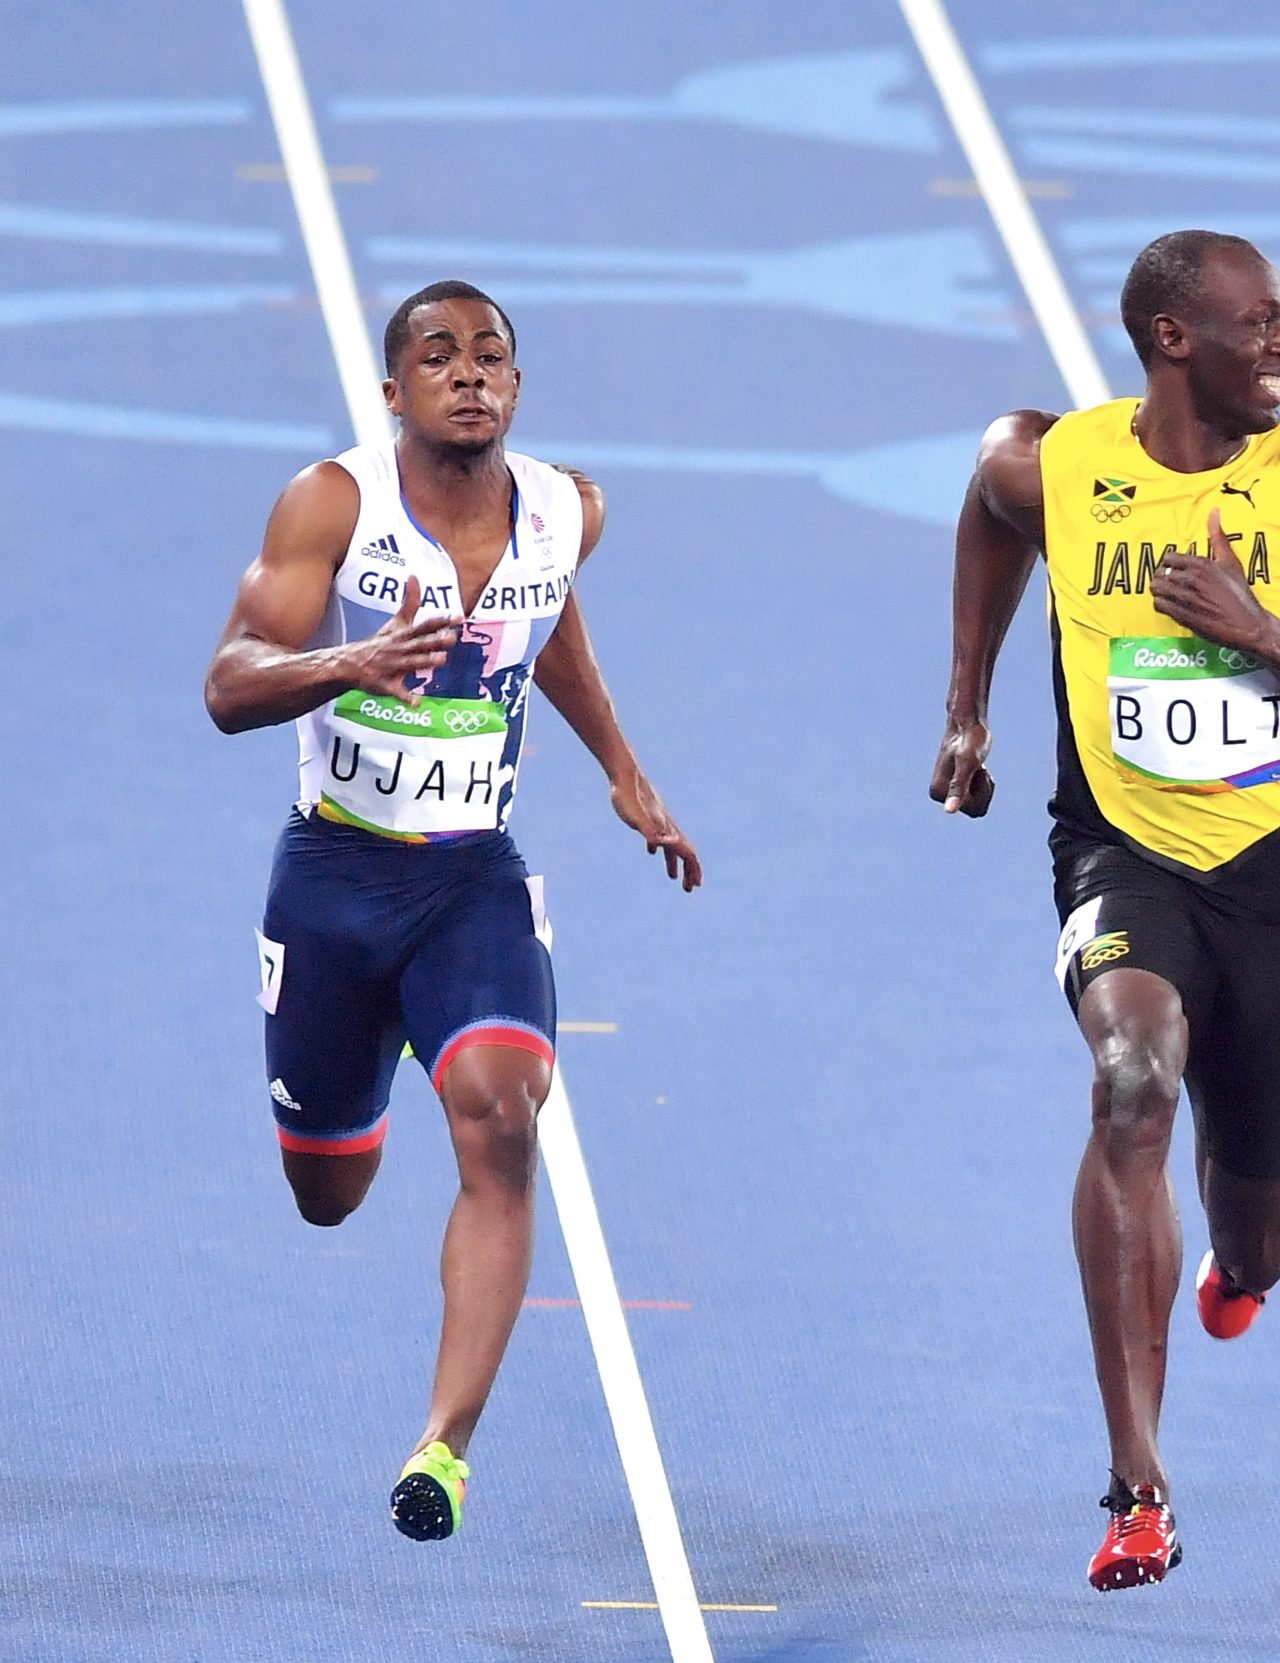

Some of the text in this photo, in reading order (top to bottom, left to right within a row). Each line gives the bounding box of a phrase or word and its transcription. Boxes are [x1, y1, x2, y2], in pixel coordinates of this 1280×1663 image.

[361, 547, 406, 567] adidas
[1087, 532, 1271, 596] JAMA
[481, 569, 574, 610] BRITAIN
[331, 735, 492, 805] UJAH
[1063, 918, 1077, 957] 6
[264, 953, 275, 988] 7
